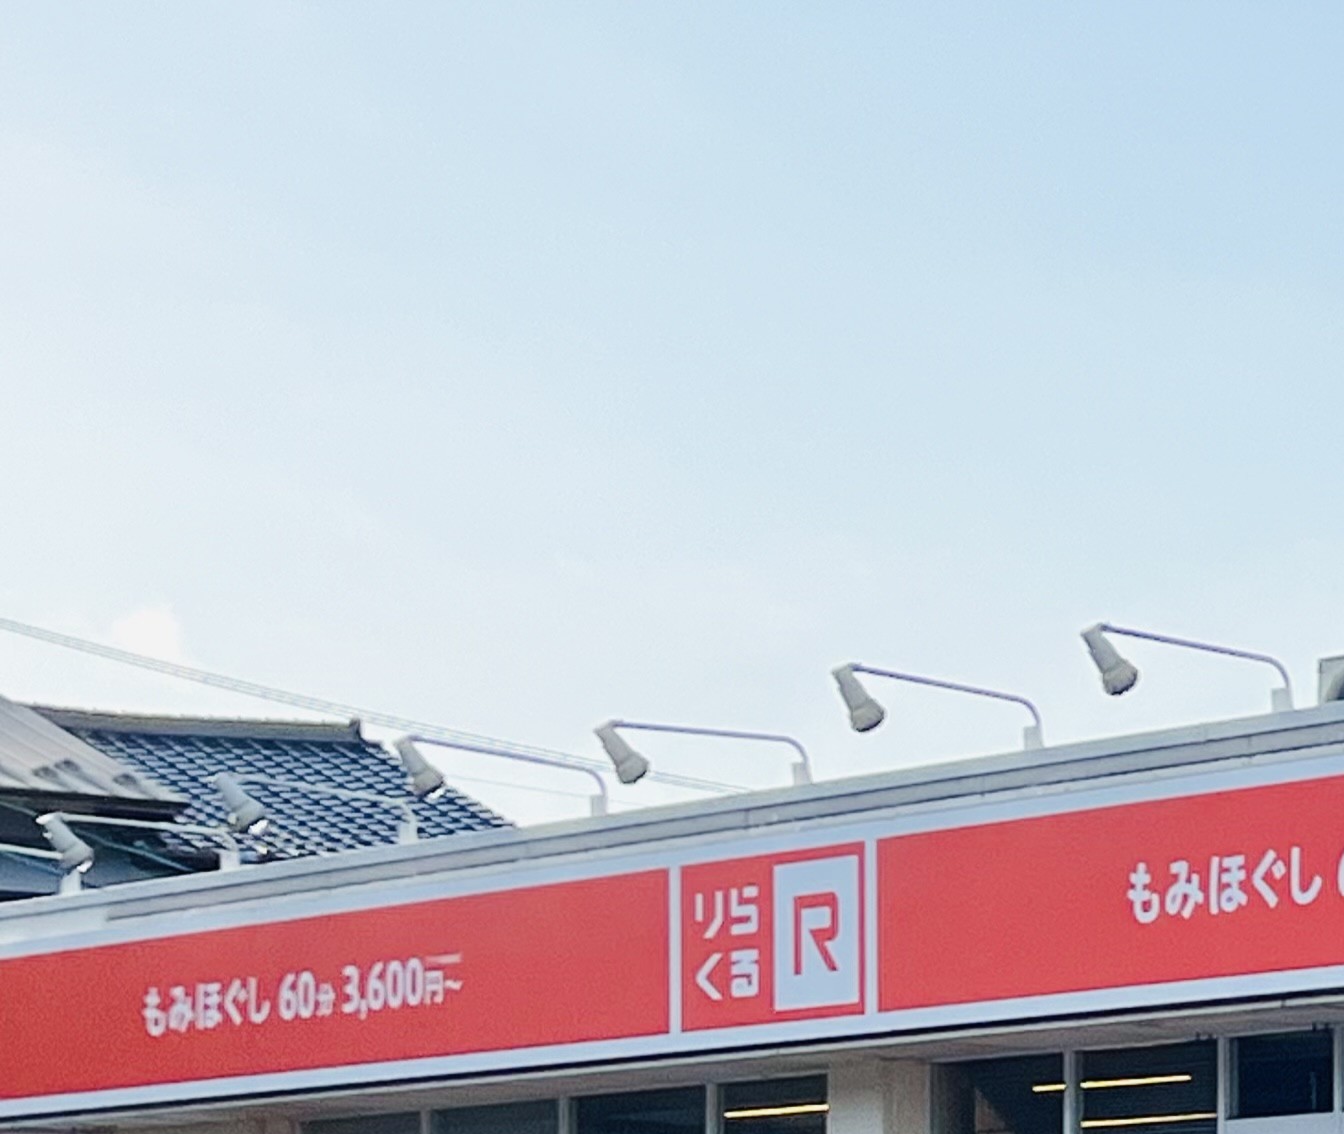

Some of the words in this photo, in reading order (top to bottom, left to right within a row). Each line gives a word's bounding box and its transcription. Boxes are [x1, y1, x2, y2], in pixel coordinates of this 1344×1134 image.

[1127, 846, 1322, 924] もみほぐし
[793, 891, 840, 976] R
[143, 976, 271, 1037] もみほぐし
[278, 970, 335, 1021] 60分
